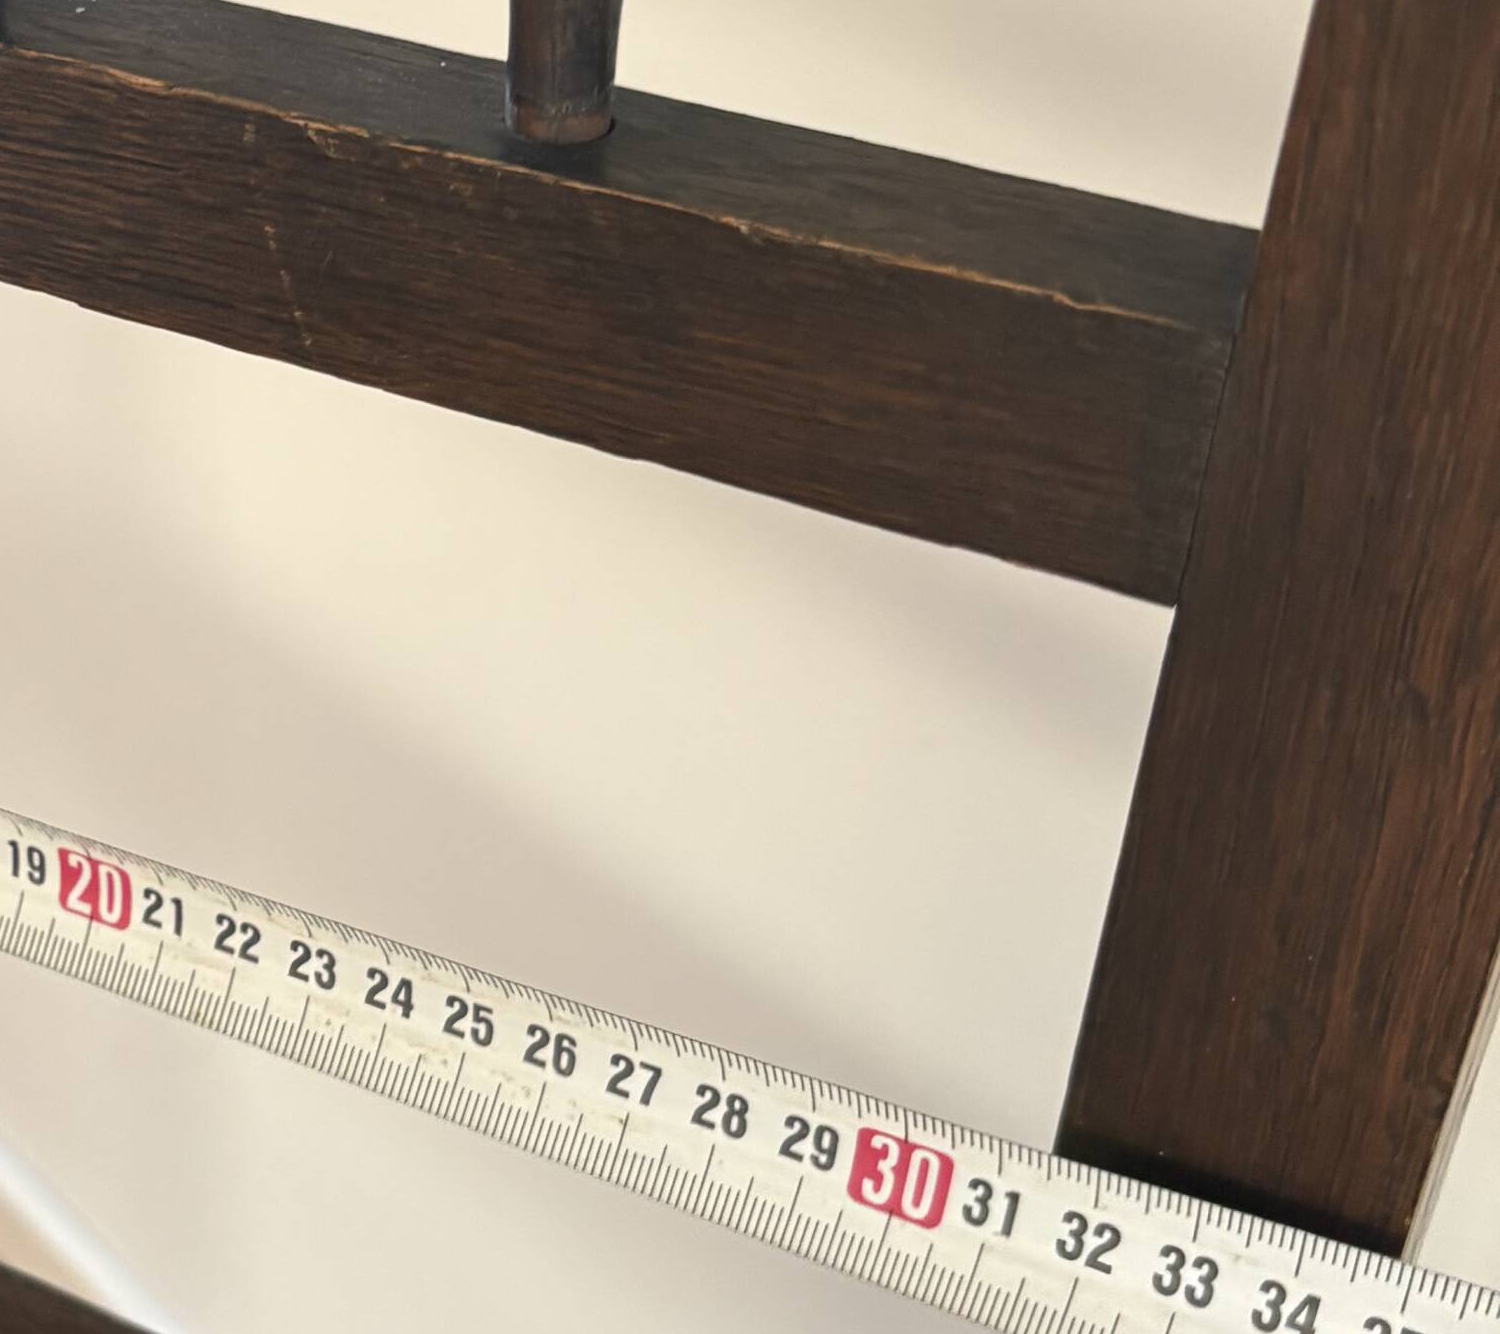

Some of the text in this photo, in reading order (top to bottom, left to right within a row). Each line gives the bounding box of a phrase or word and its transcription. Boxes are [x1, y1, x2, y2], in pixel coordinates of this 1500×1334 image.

[8, 840, 46, 886] 19
[65, 850, 124, 926] 20
[143, 887, 184, 937] 21
[214, 913, 262, 964] 22
[288, 939, 337, 991] 23
[364, 967, 415, 1019] 24
[442, 995, 495, 1048] 25
[523, 1024, 578, 1078] 26
[606, 1053, 663, 1107] 27
[691, 1084, 750, 1139] 28
[778, 1114, 840, 1172] 29
[861, 1134, 941, 1221] 30
[962, 1177, 1021, 1238] 31
[1055, 1210, 1122, 1275] 32
[1152, 1244, 1219, 1308] 33
